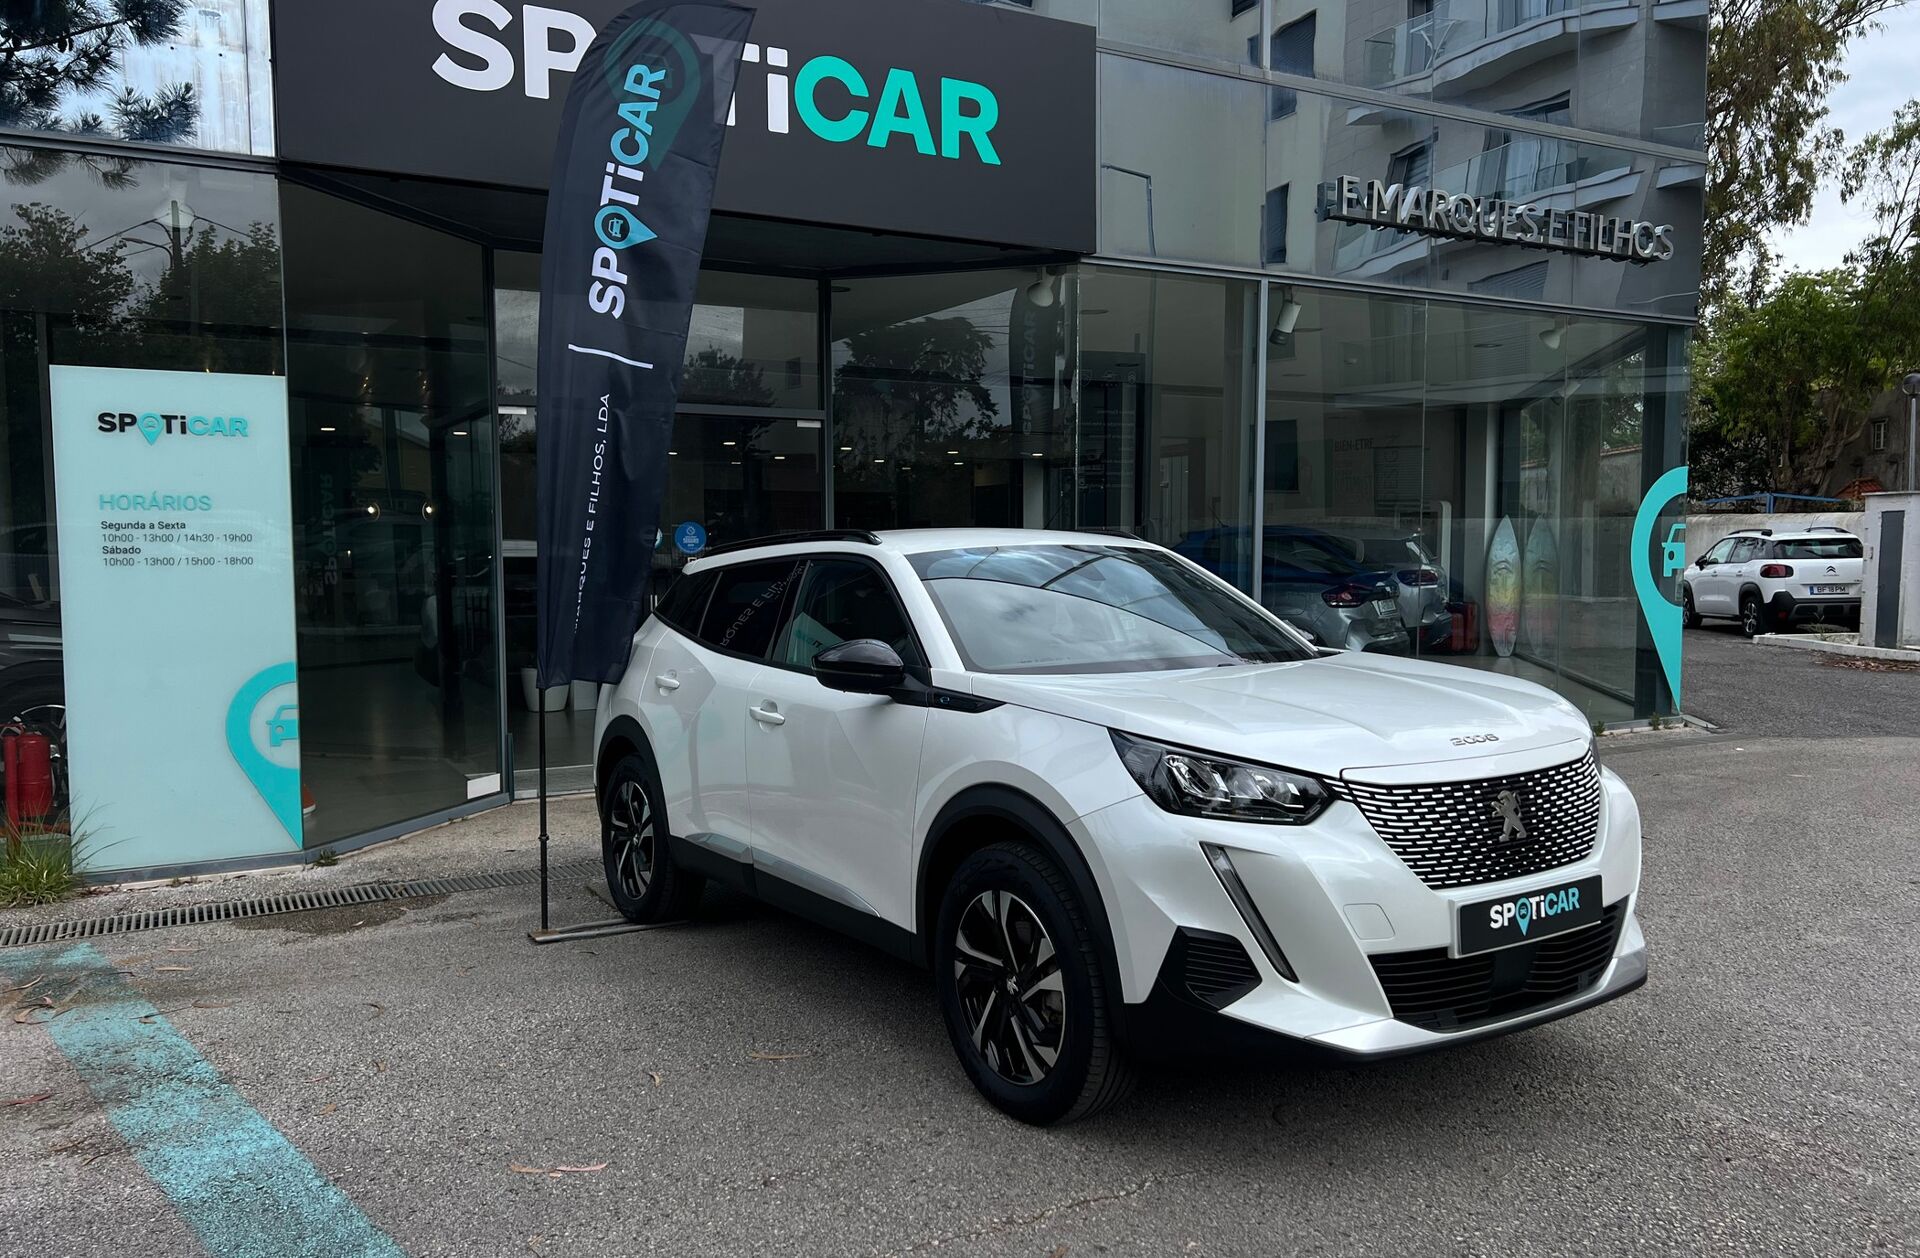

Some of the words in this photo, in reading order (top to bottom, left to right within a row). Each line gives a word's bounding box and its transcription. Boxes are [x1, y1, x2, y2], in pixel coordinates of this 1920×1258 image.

[1368, 178, 1538, 243] MARQUES
[1546, 208, 1569, 246] E
[1571, 210, 1675, 262] FILHOS
[596, 393, 610, 433] LDA
[588, 439, 607, 514] FILHOS,
[99, 490, 213, 512] HORÁRIOS
[101, 521, 146, 532] Segunda
[158, 521, 186, 530] Sexta
[586, 519, 595, 531] E
[102, 533, 134, 543] 10h00
[143, 533, 174, 543] 13h00
[184, 533, 214, 543] 14h30
[223, 533, 253, 543] 19h00
[102, 545, 142, 555] Sábado
[103, 557, 135, 567] 10h00
[145, 557, 175, 566] 13h00
[185, 556, 215, 566] 15h00
[224, 556, 254, 565] 18h00
[1489, 886, 1580, 937] SPOTiCAR
